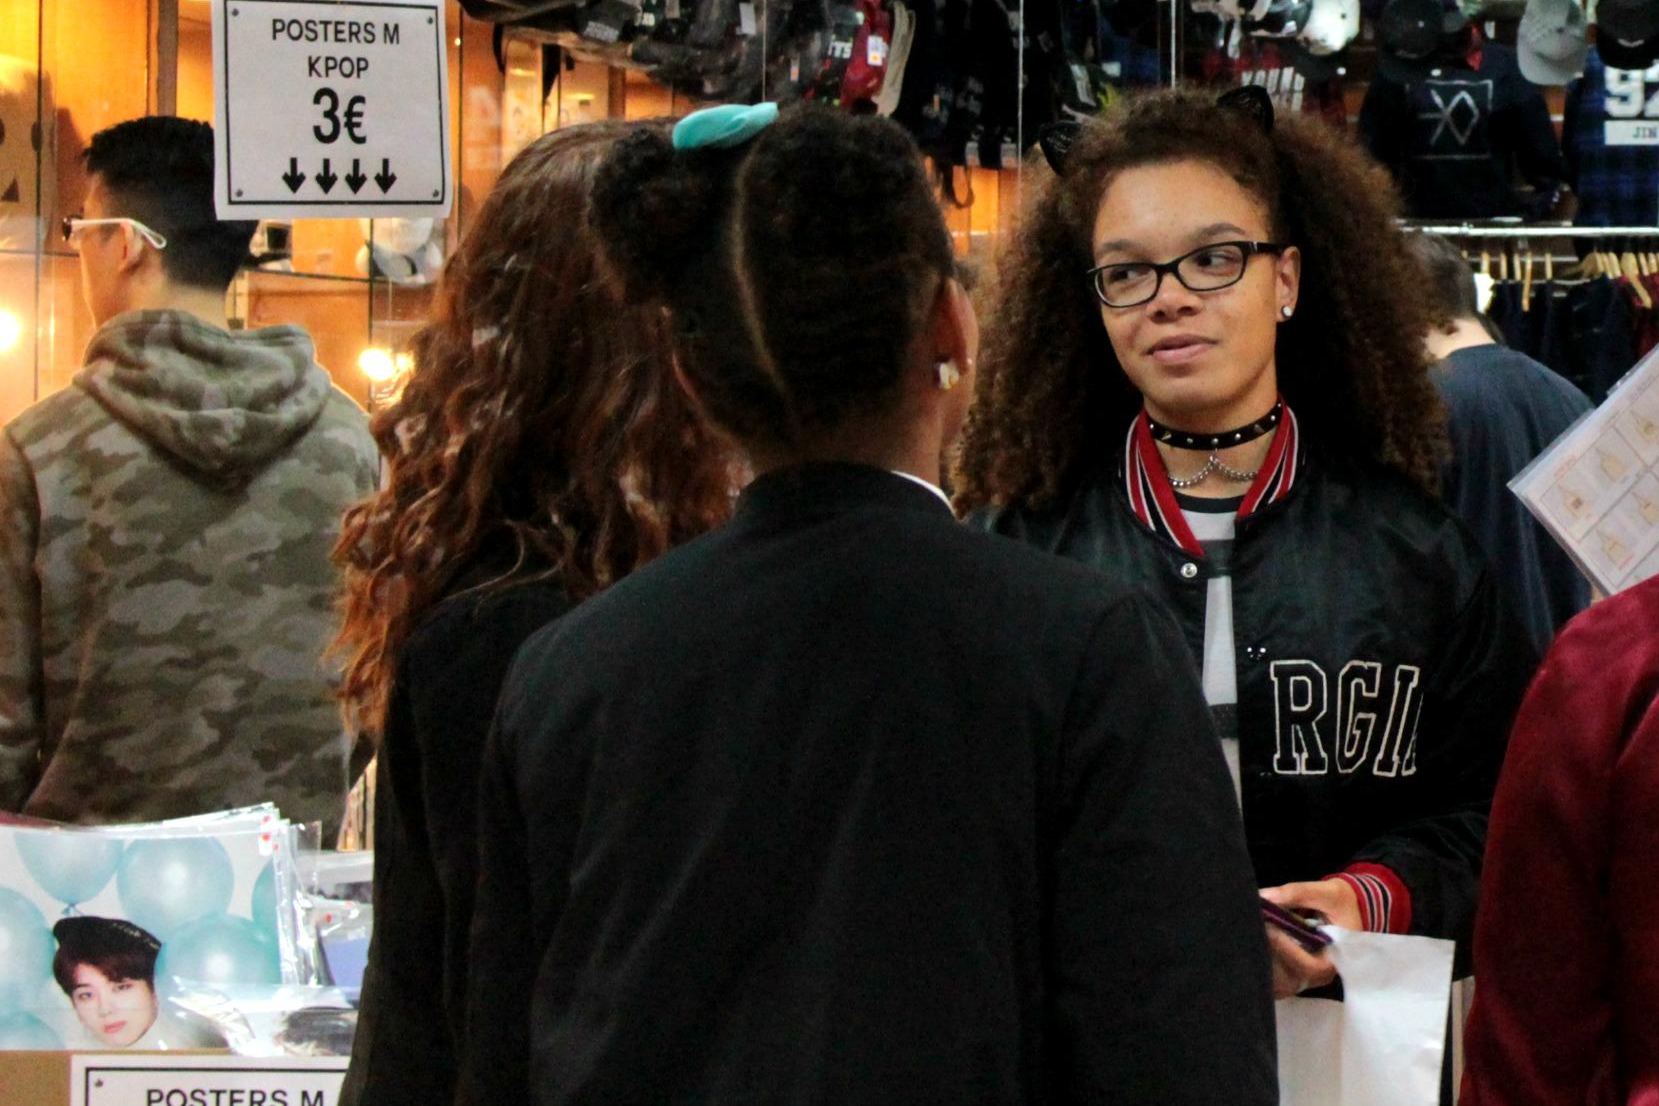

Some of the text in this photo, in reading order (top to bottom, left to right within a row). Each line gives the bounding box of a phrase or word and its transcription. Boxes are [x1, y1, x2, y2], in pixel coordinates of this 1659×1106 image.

[271, 17, 400, 46] POSTERS M
[307, 55, 370, 79] KPOP
[312, 86, 367, 145] 3€
[1632, 125, 1658, 139] JIN
[146, 1088, 325, 1106] POSTERS M
